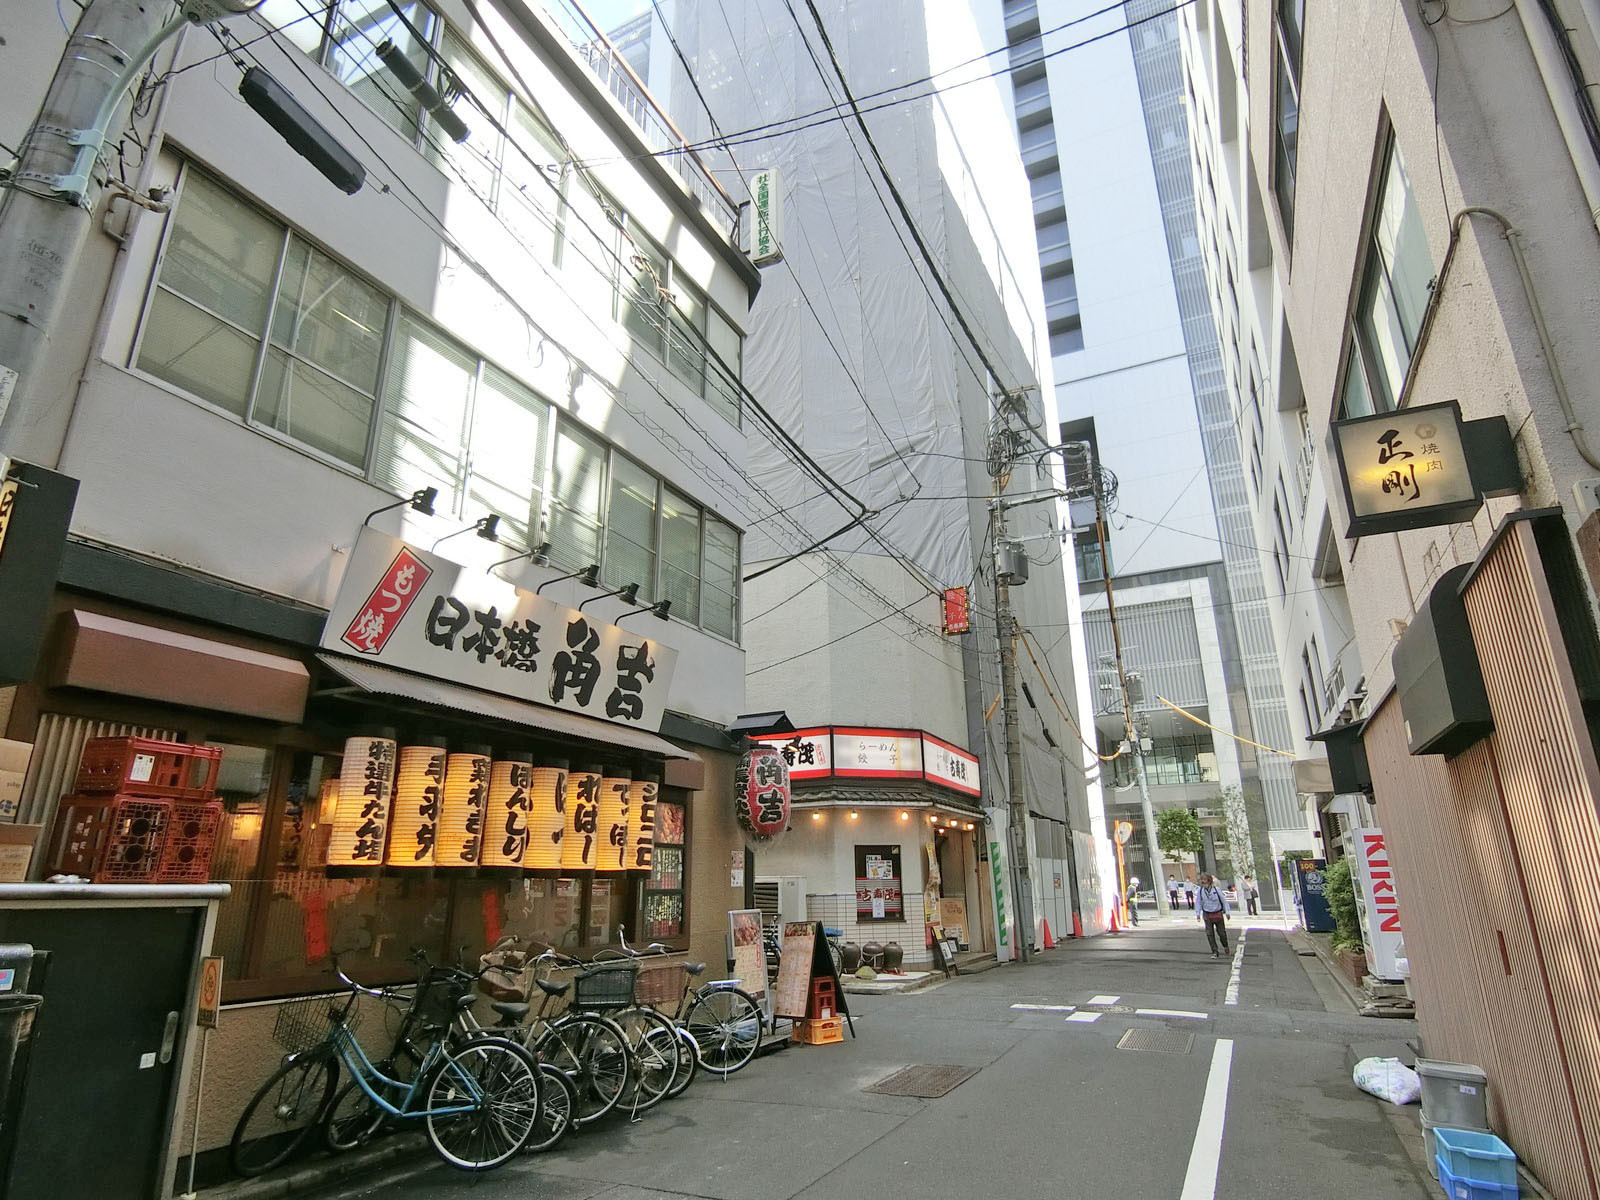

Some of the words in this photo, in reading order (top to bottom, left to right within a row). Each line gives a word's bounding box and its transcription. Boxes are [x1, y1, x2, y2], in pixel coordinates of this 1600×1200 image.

[1420, 442, 1443, 472] 焼肉
[352, 563, 417, 650] もつ焼
[424, 595, 542, 673] 日本橋
[550, 617, 656, 721] 角吉
[756, 755, 784, 824] 角吉
[1362, 835, 1402, 932] KIRIN
